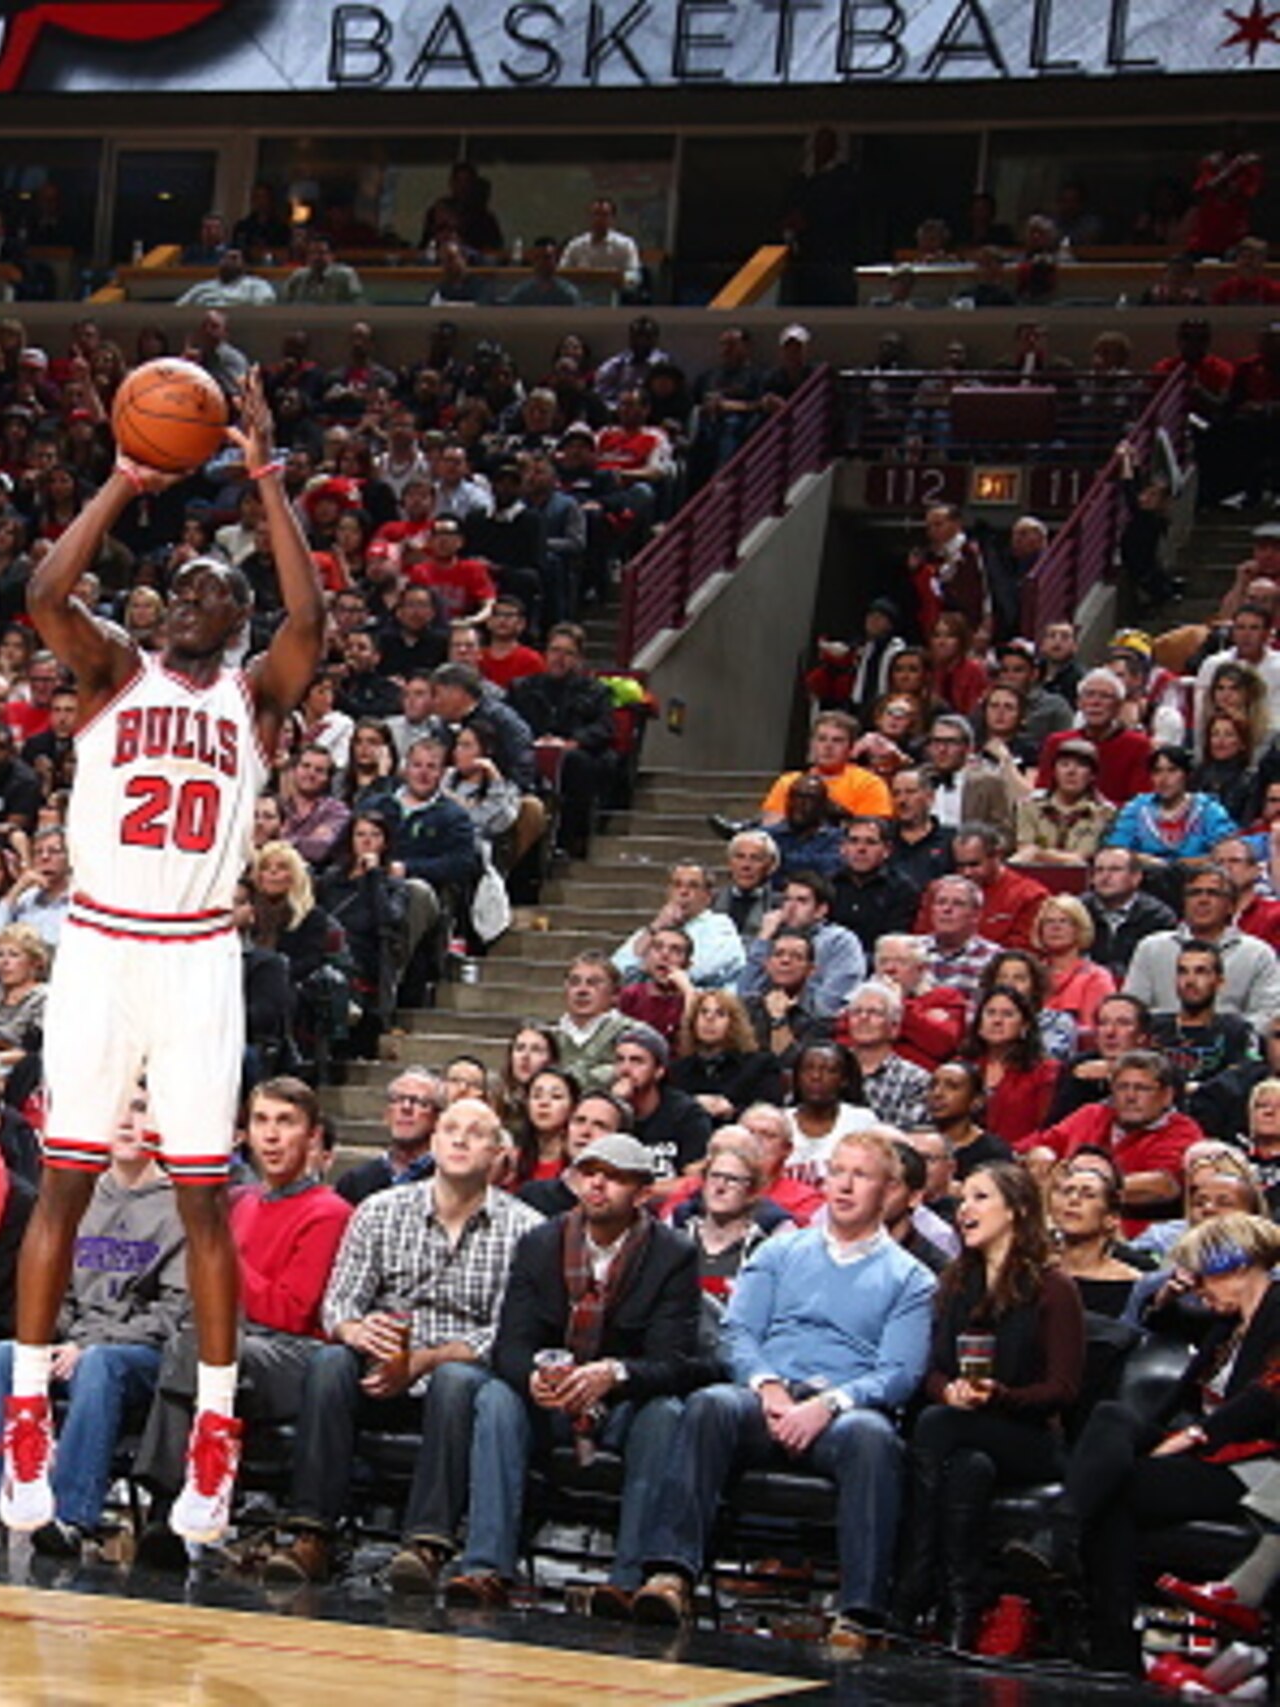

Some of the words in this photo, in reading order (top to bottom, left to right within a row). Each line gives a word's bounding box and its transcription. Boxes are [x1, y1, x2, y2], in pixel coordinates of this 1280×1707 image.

[326, 0, 1163, 84] BASKETBALL
[884, 467, 946, 505] 112
[112, 705, 239, 779] BULLS
[120, 775, 221, 854] 20
